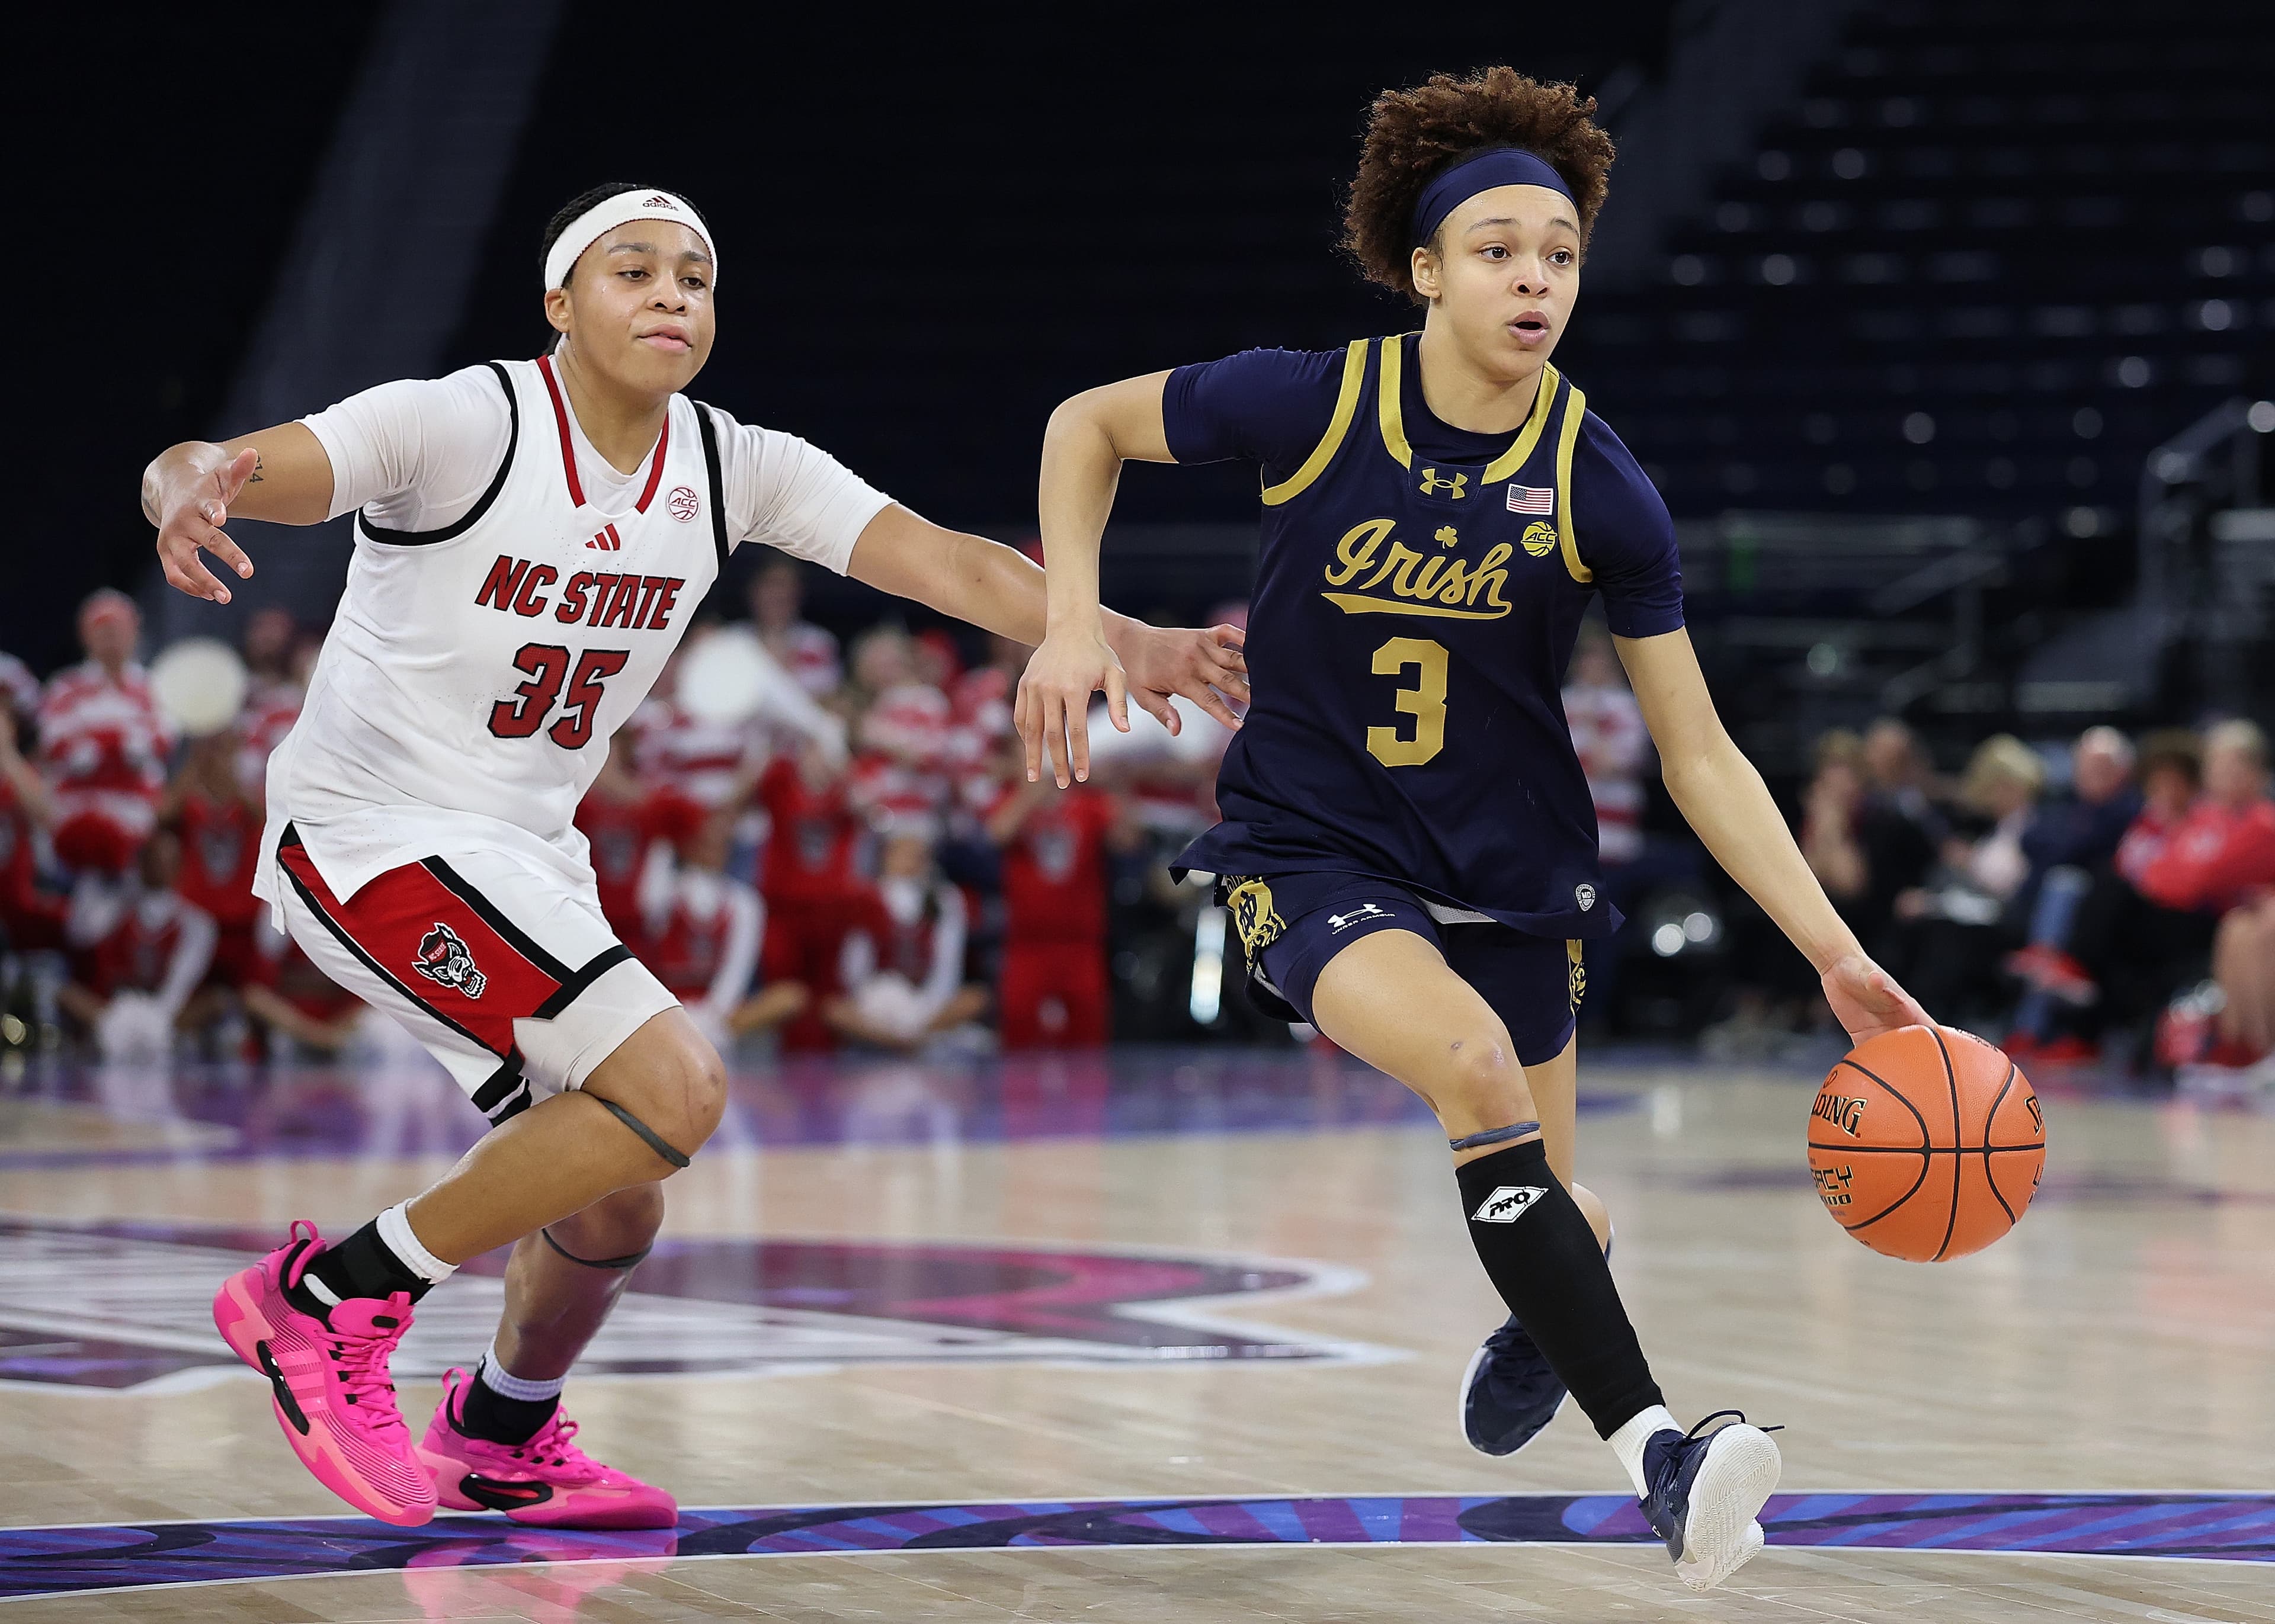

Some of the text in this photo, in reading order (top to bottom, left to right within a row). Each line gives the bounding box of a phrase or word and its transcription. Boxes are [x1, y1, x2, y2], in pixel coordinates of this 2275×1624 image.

[642, 201, 679, 211] adidas
[671, 498, 697, 508] ACC
[1525, 532, 1557, 542] ACC
[1324, 518, 1513, 612] Irish
[475, 554, 685, 630] NC STATE
[487, 642, 630, 750] 35
[1366, 637, 1449, 768] 3
[1331, 913, 1396, 935] UNDER ARMOUR
[1489, 1191, 1530, 1219] PRO
